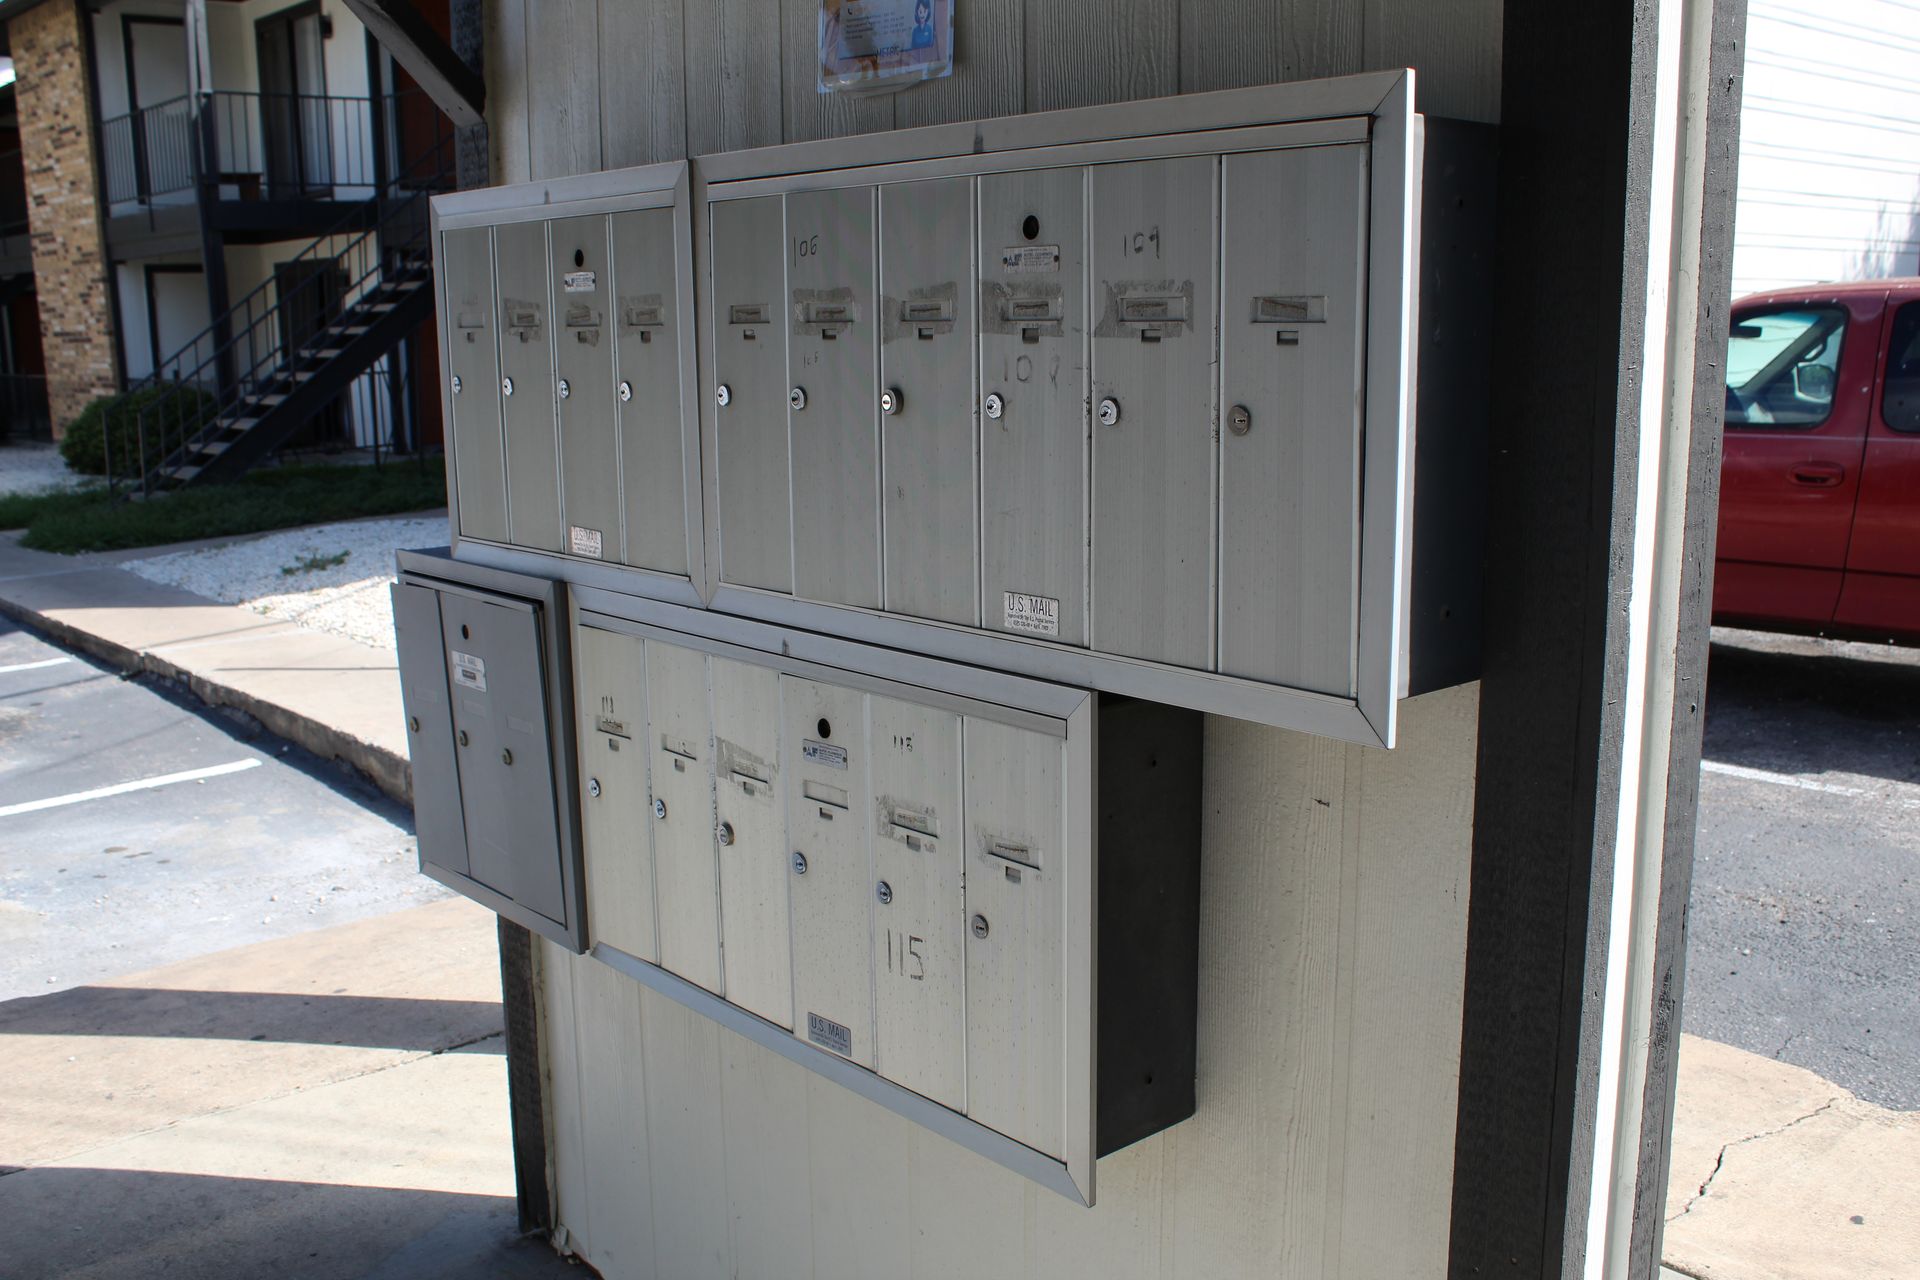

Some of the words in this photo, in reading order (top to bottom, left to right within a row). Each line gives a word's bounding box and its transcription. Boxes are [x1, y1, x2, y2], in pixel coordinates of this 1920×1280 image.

[793, 234, 819, 267] 106
[1008, 594, 1027, 613] U.S.
[1028, 598, 1053, 617] MAIL
[887, 928, 924, 981] 115
[811, 1015, 826, 1034] U.S.
[828, 1023, 847, 1042] MAIL
